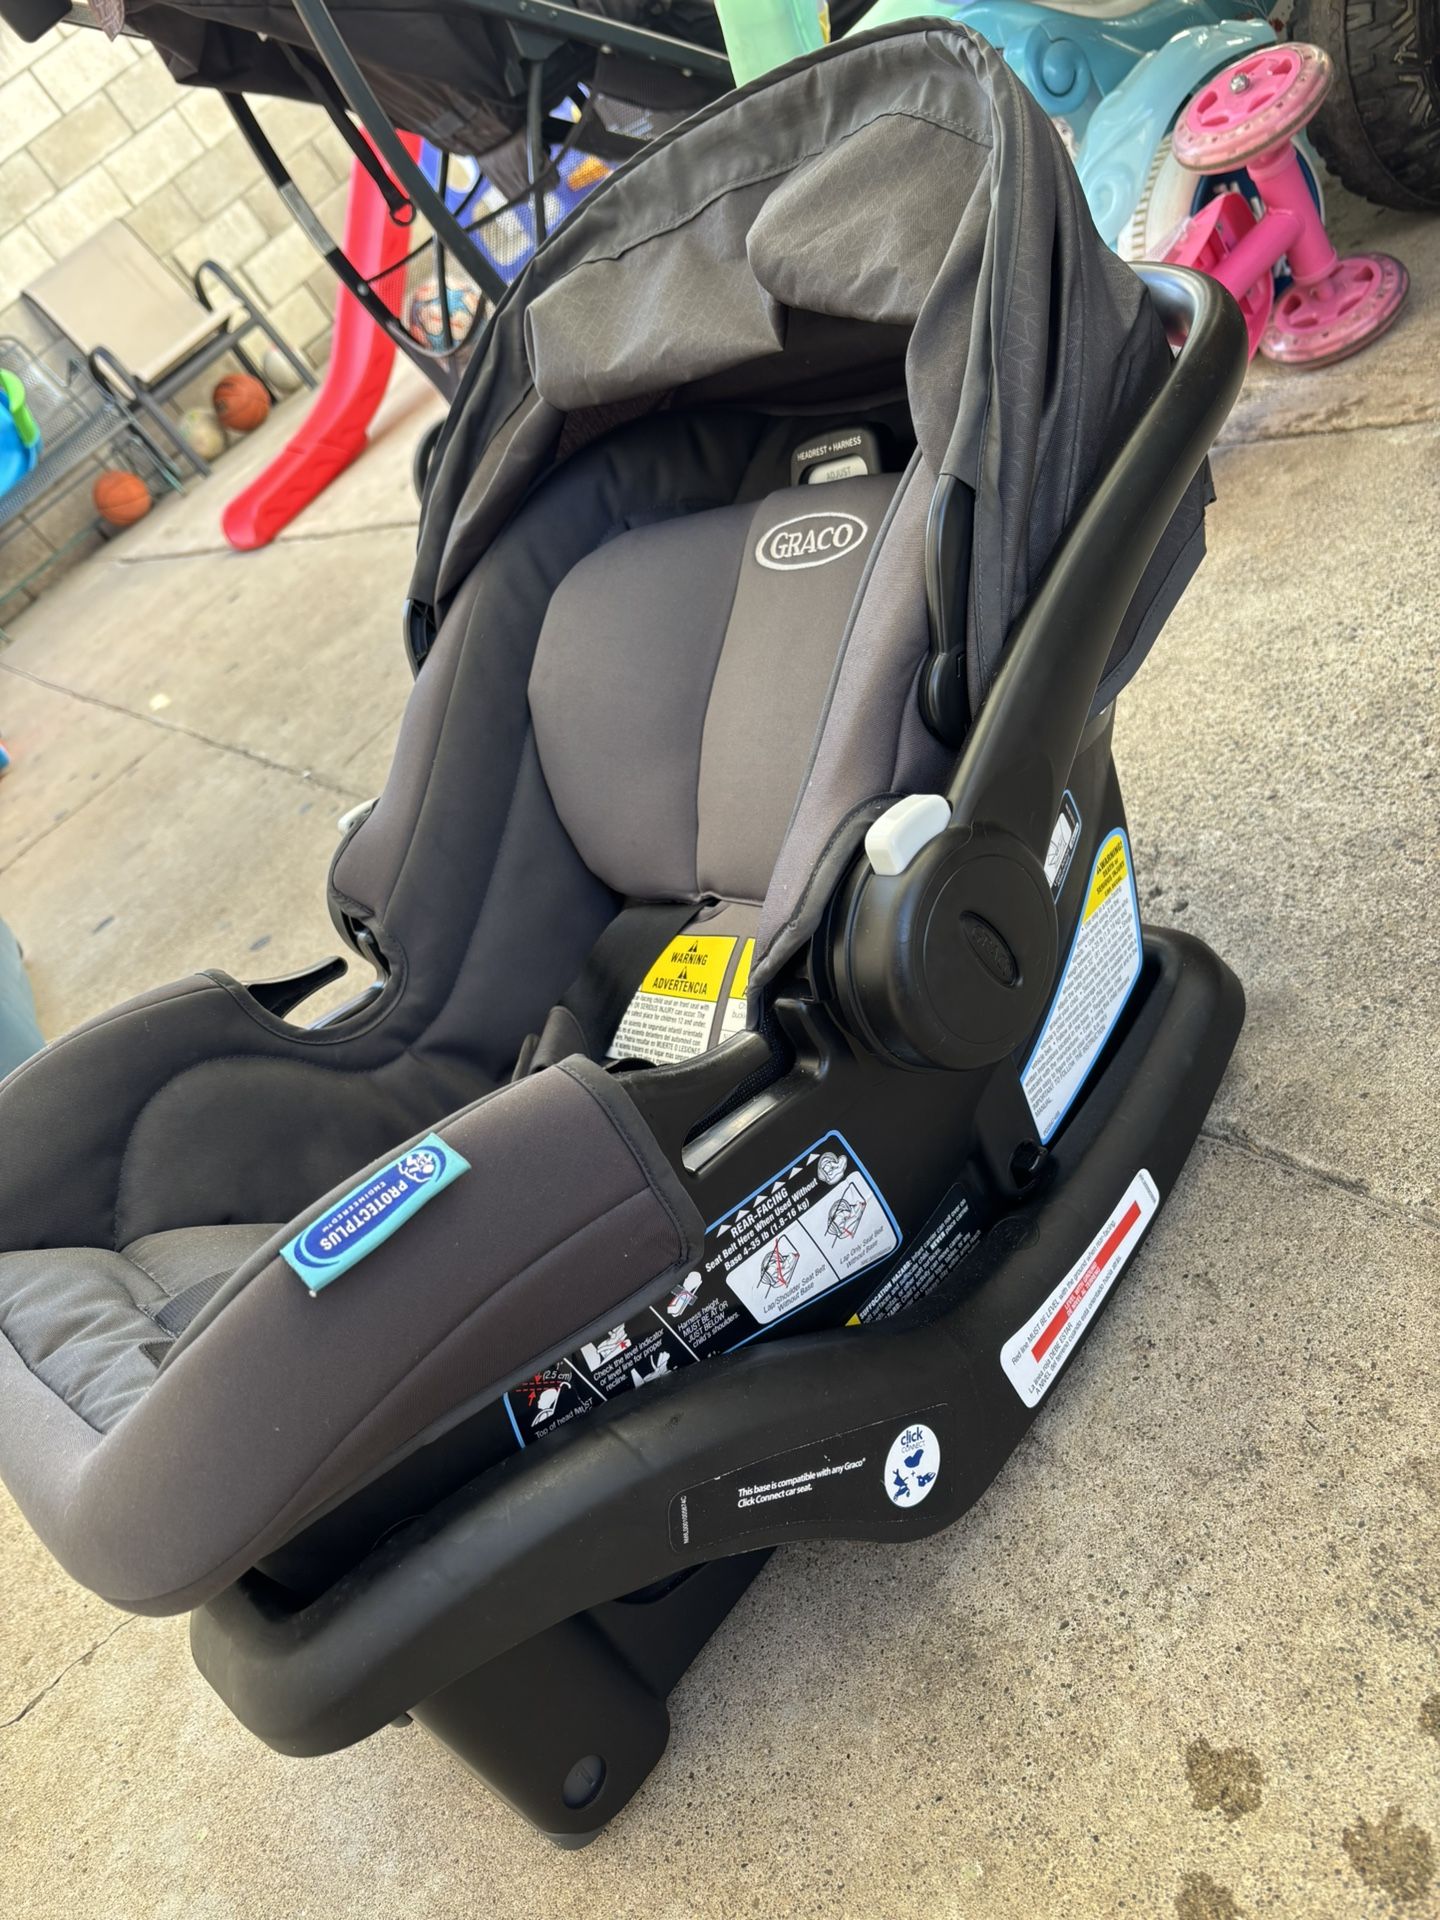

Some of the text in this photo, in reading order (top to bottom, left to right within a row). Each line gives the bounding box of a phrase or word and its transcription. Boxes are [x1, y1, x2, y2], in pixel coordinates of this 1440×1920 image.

[797, 444, 827, 461] HEADREST
[833, 436, 862, 452] HARNESS
[826, 466, 851, 479] ADJUST
[770, 524, 853, 559] GRACO
[671, 953, 708, 966] WARNING
[652, 978, 708, 994] ADVERTENCIA
[319, 1180, 409, 1252] PROTECTPLUS
[704, 1177, 818, 1272] Seat Belt Here When Used Without
[729, 1186, 788, 1238] REAR-FACING
[723, 1197, 810, 1270] Base 4-35 lb (1.8-16 kg)
[838, 1252, 849, 1264] Lap
[861, 1233, 874, 1245] Seat
[873, 1225, 883, 1236] Belt
[845, 1250, 865, 1267] Without
[864, 1240, 878, 1253] Base
[859, 1281, 892, 1319] SUFFOCATION
[911, 1245, 923, 1261] Infant
[923, 1230, 936, 1248] carrier
[936, 1222, 944, 1233] can
[943, 1214, 951, 1224] roll
[950, 1204, 960, 1216] over
[959, 1197, 966, 1206] on
[762, 1264, 827, 1314] Lap/Shoulder Seat Belt
[777, 1281, 815, 1311] Without Base
[1011, 1350, 1021, 1364] Red
[1020, 1340, 1028, 1353] line
[1027, 1323, 1040, 1343] MUST
[1039, 1314, 1047, 1326] BE
[1045, 1298, 1059, 1317] LEVEL
[1058, 1286, 1067, 1299] with
[1073, 1259, 1086, 1279] ground
[1086, 1245, 1096, 1261] when
[677, 1297, 719, 1331] Harness height
[682, 1300, 728, 1337] MUST BE AT OR
[687, 1311, 725, 1342] JUST BELOW
[593, 1327, 664, 1381] Check the level indicator
[692, 1330, 711, 1348] child's
[558, 1372, 571, 1381] cm)
[599, 1338, 662, 1386] or level line for proper
[534, 1426, 548, 1438] Top
[548, 1421, 556, 1430] of
[556, 1410, 574, 1425] head
[737, 1497, 755, 1507] Click
[755, 1490, 785, 1503] Connect
[796, 1483, 812, 1493] seat.
[738, 1486, 753, 1497] This
[753, 1483, 770, 1493] base
[771, 1481, 777, 1489] is
[777, 1472, 816, 1487] compatible
[815, 1467, 831, 1477] with
[831, 1465, 844, 1474] any
